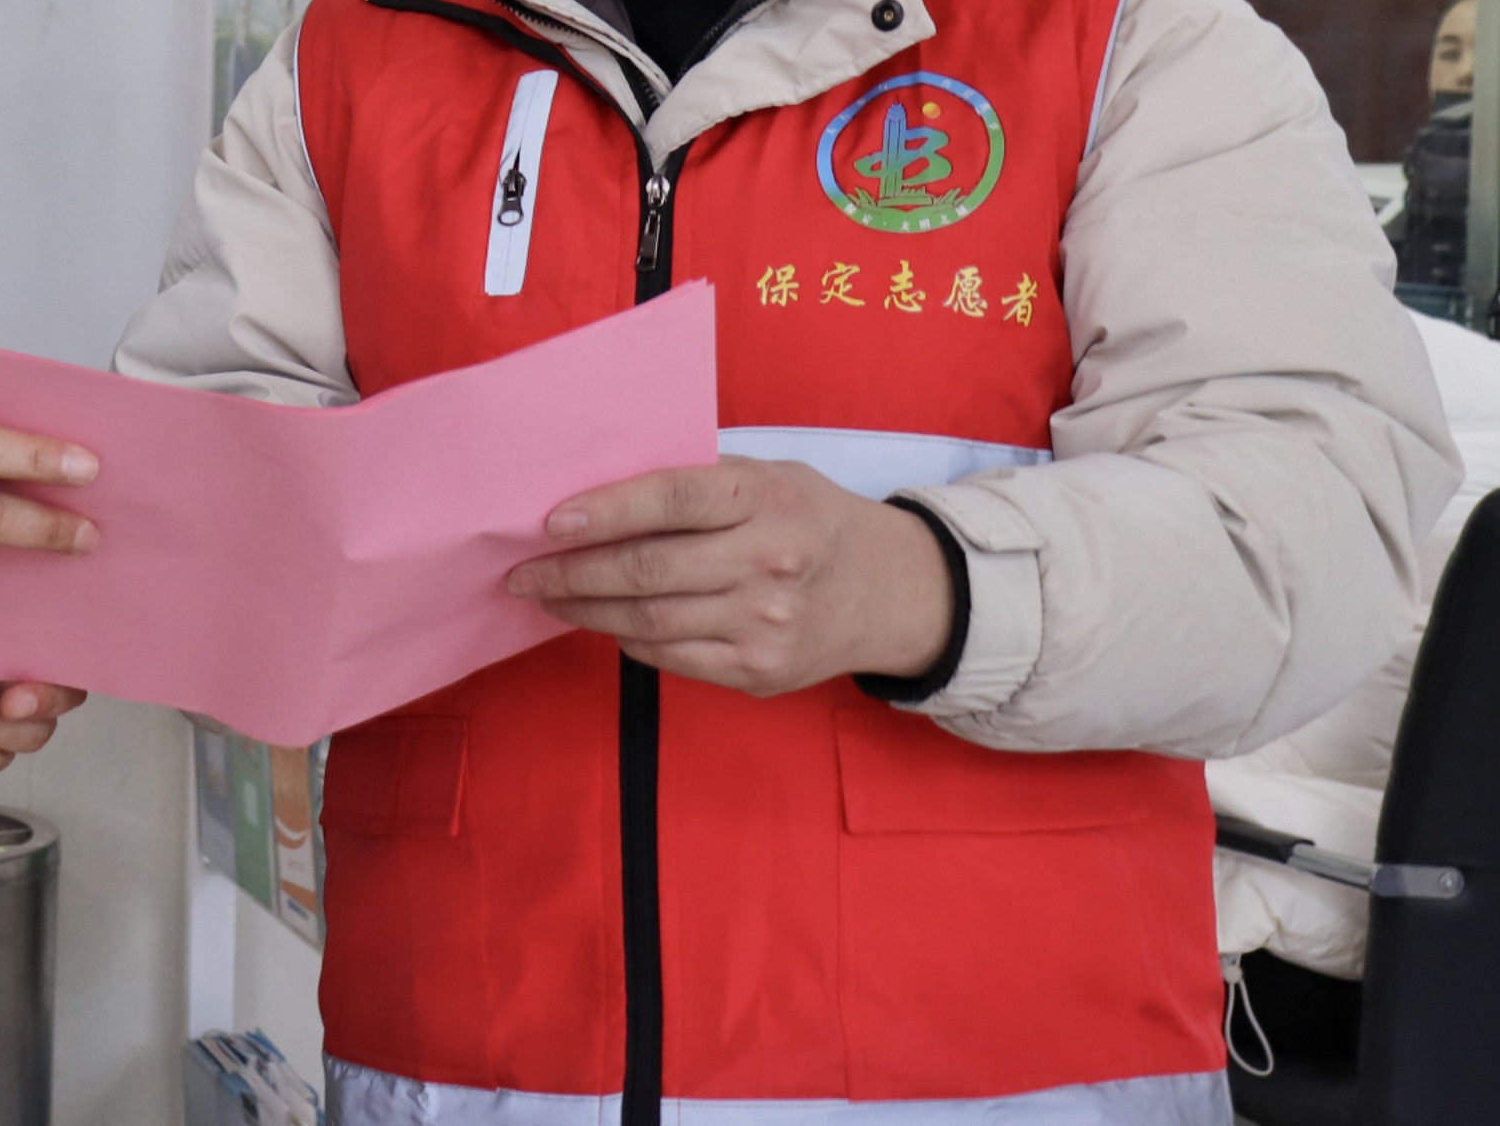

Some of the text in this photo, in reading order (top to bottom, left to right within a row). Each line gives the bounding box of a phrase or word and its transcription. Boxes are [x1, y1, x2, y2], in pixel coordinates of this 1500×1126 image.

[756, 260, 1039, 327] 保定志愿者
